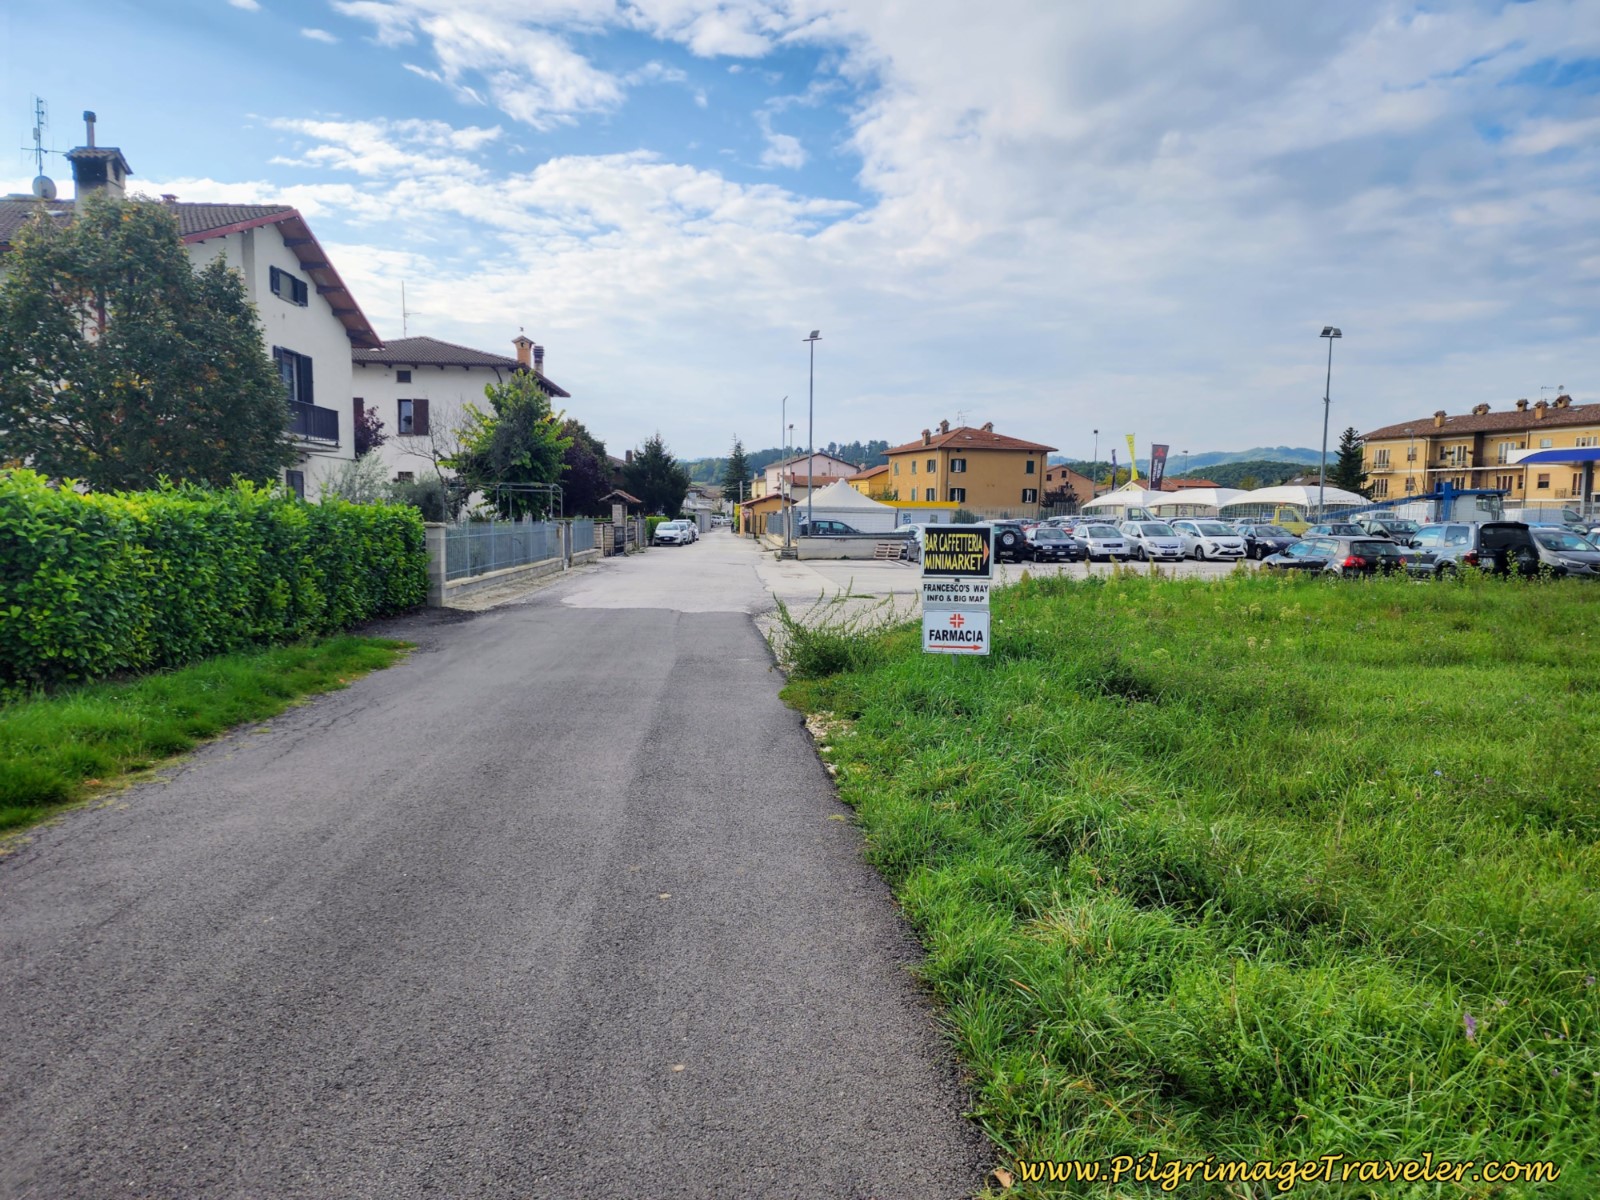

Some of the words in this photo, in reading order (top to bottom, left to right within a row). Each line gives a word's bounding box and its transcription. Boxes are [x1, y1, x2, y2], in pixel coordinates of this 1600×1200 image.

[925, 534, 938, 551] BAR
[939, 533, 983, 552] CAFFETTERIA
[924, 554, 982, 571] MINIMARKET
[923, 584, 970, 593] FRANCESCO'S
[973, 585, 989, 593] WAY
[929, 629, 984, 643] FARMACIA
